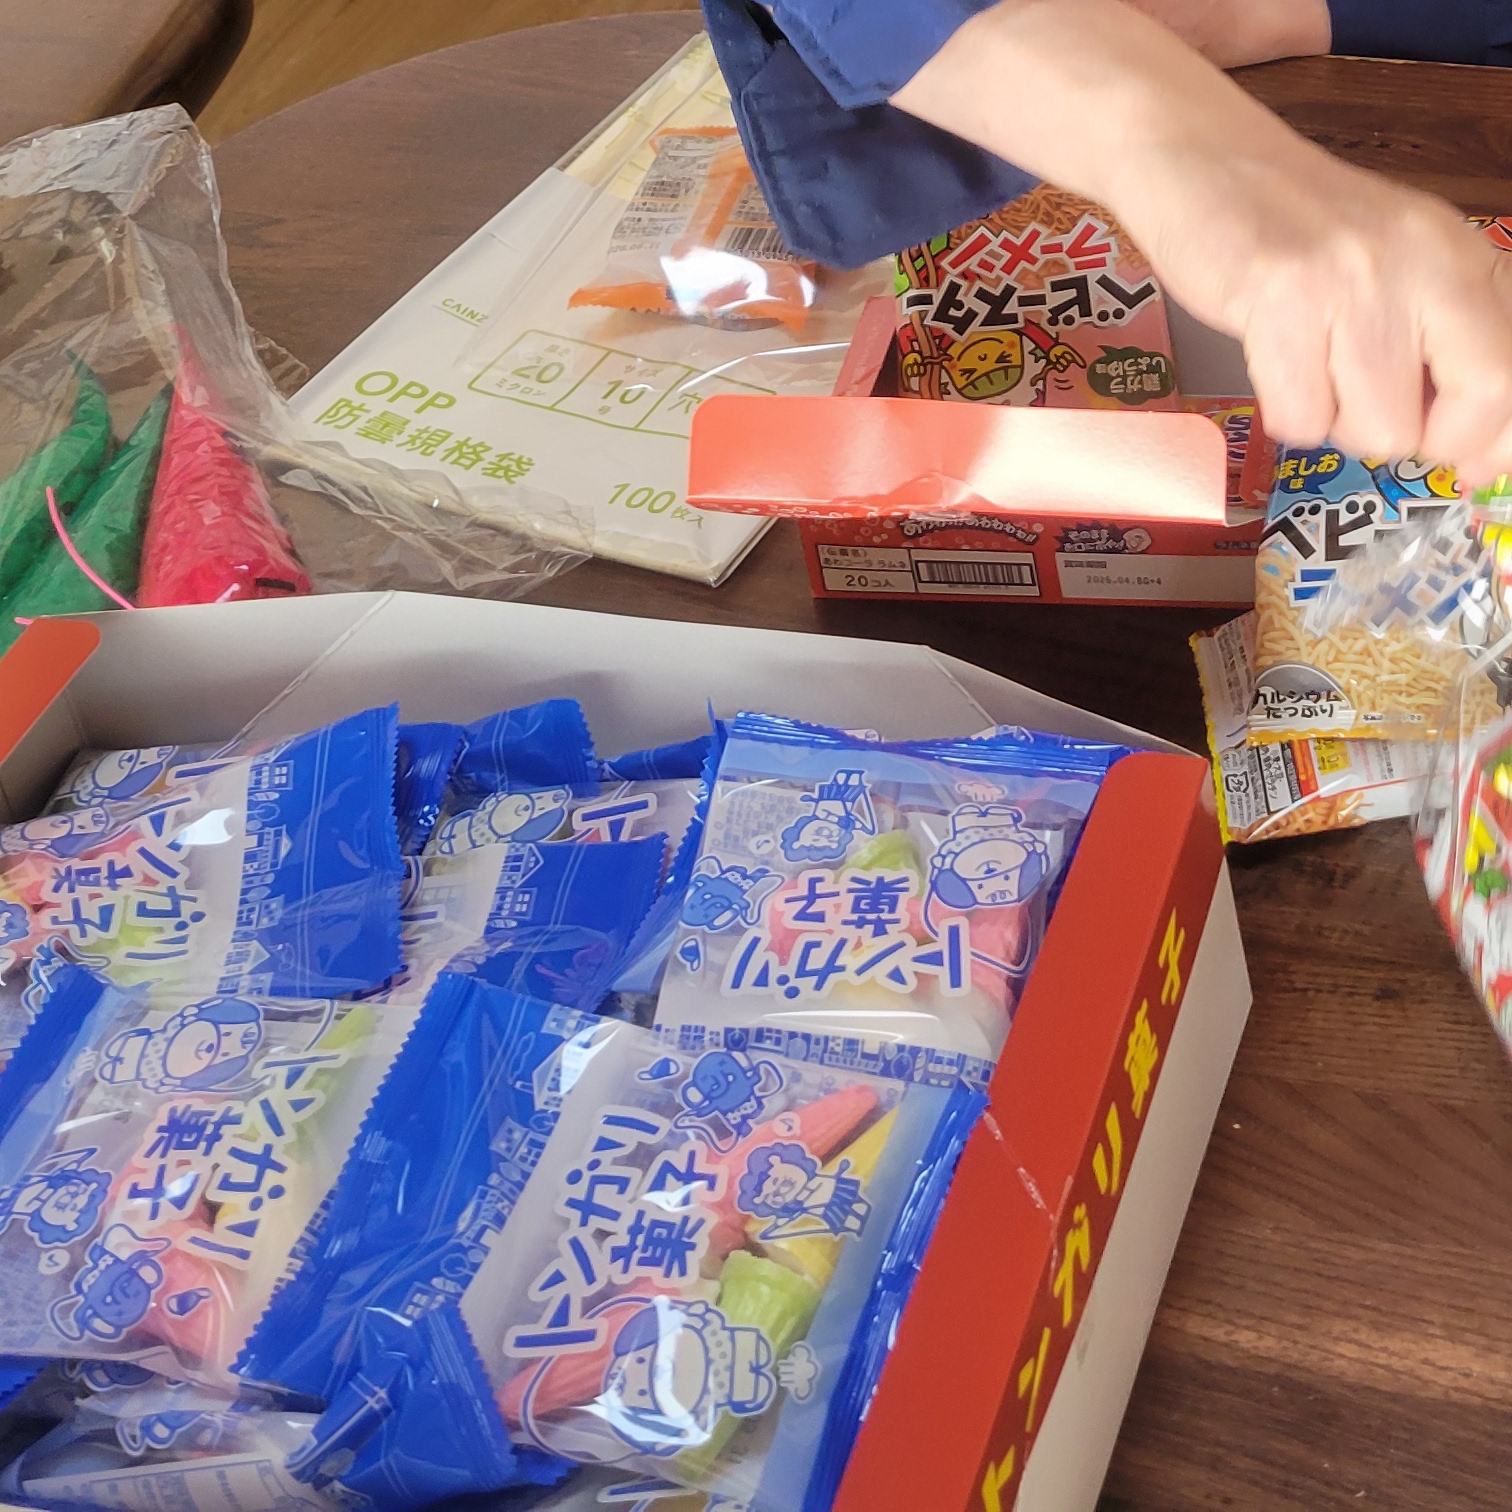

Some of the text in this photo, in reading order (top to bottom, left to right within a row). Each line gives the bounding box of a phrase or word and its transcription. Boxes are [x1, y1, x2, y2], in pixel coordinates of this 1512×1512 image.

[948, 222, 1112, 277] ラーメン
[441, 297, 489, 323] CAINZ
[904, 272, 1158, 336] ベビースター
[354, 371, 457, 414] OPP
[494, 378, 548, 397] ミクロン
[600, 379, 646, 404] 10
[312, 397, 535, 484] 防曇規格袋
[608, 482, 704, 529] 100枚入
[844, 574, 896, 589] 20コ入
[49, 858, 134, 940] 菓子
[123, 795, 207, 961] トンガリ
[786, 874, 910, 937] 菓子
[730, 924, 964, 1001] トンガリ
[130, 1103, 242, 1221] 菓子
[187, 1053, 341, 1261] トンガリ
[512, 1114, 660, 1350] トンガリ
[610, 1149, 718, 1277] 菓子
